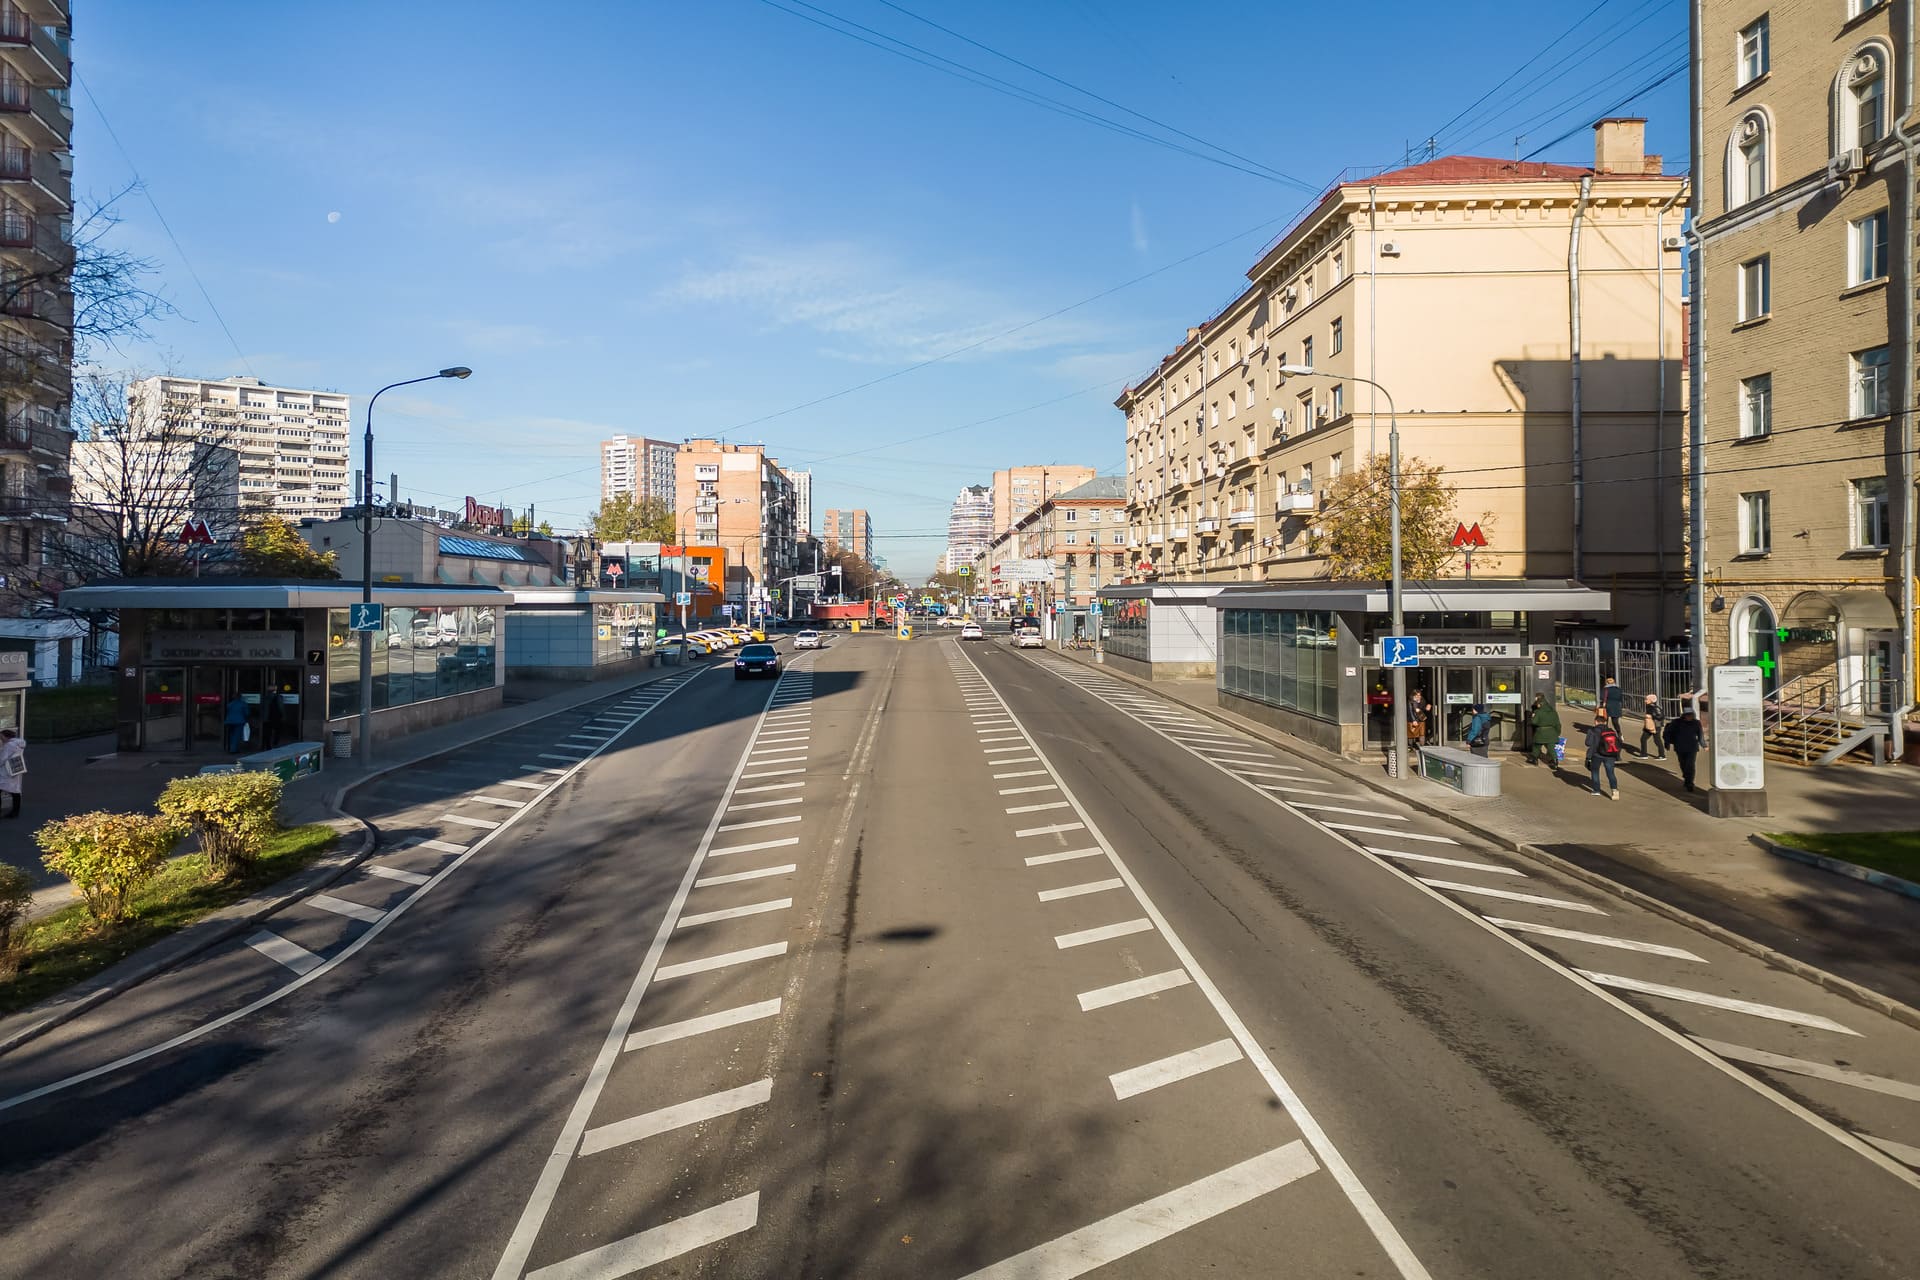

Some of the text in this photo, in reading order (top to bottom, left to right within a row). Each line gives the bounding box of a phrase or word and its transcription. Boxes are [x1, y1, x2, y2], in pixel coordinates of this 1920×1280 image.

[1418, 645, 1507, 656] БРЬСКОЕ ПОЛЕ
[0, 654, 25, 664] ССА
[311, 652, 320, 661] 7
[1538, 651, 1548, 662] 6
